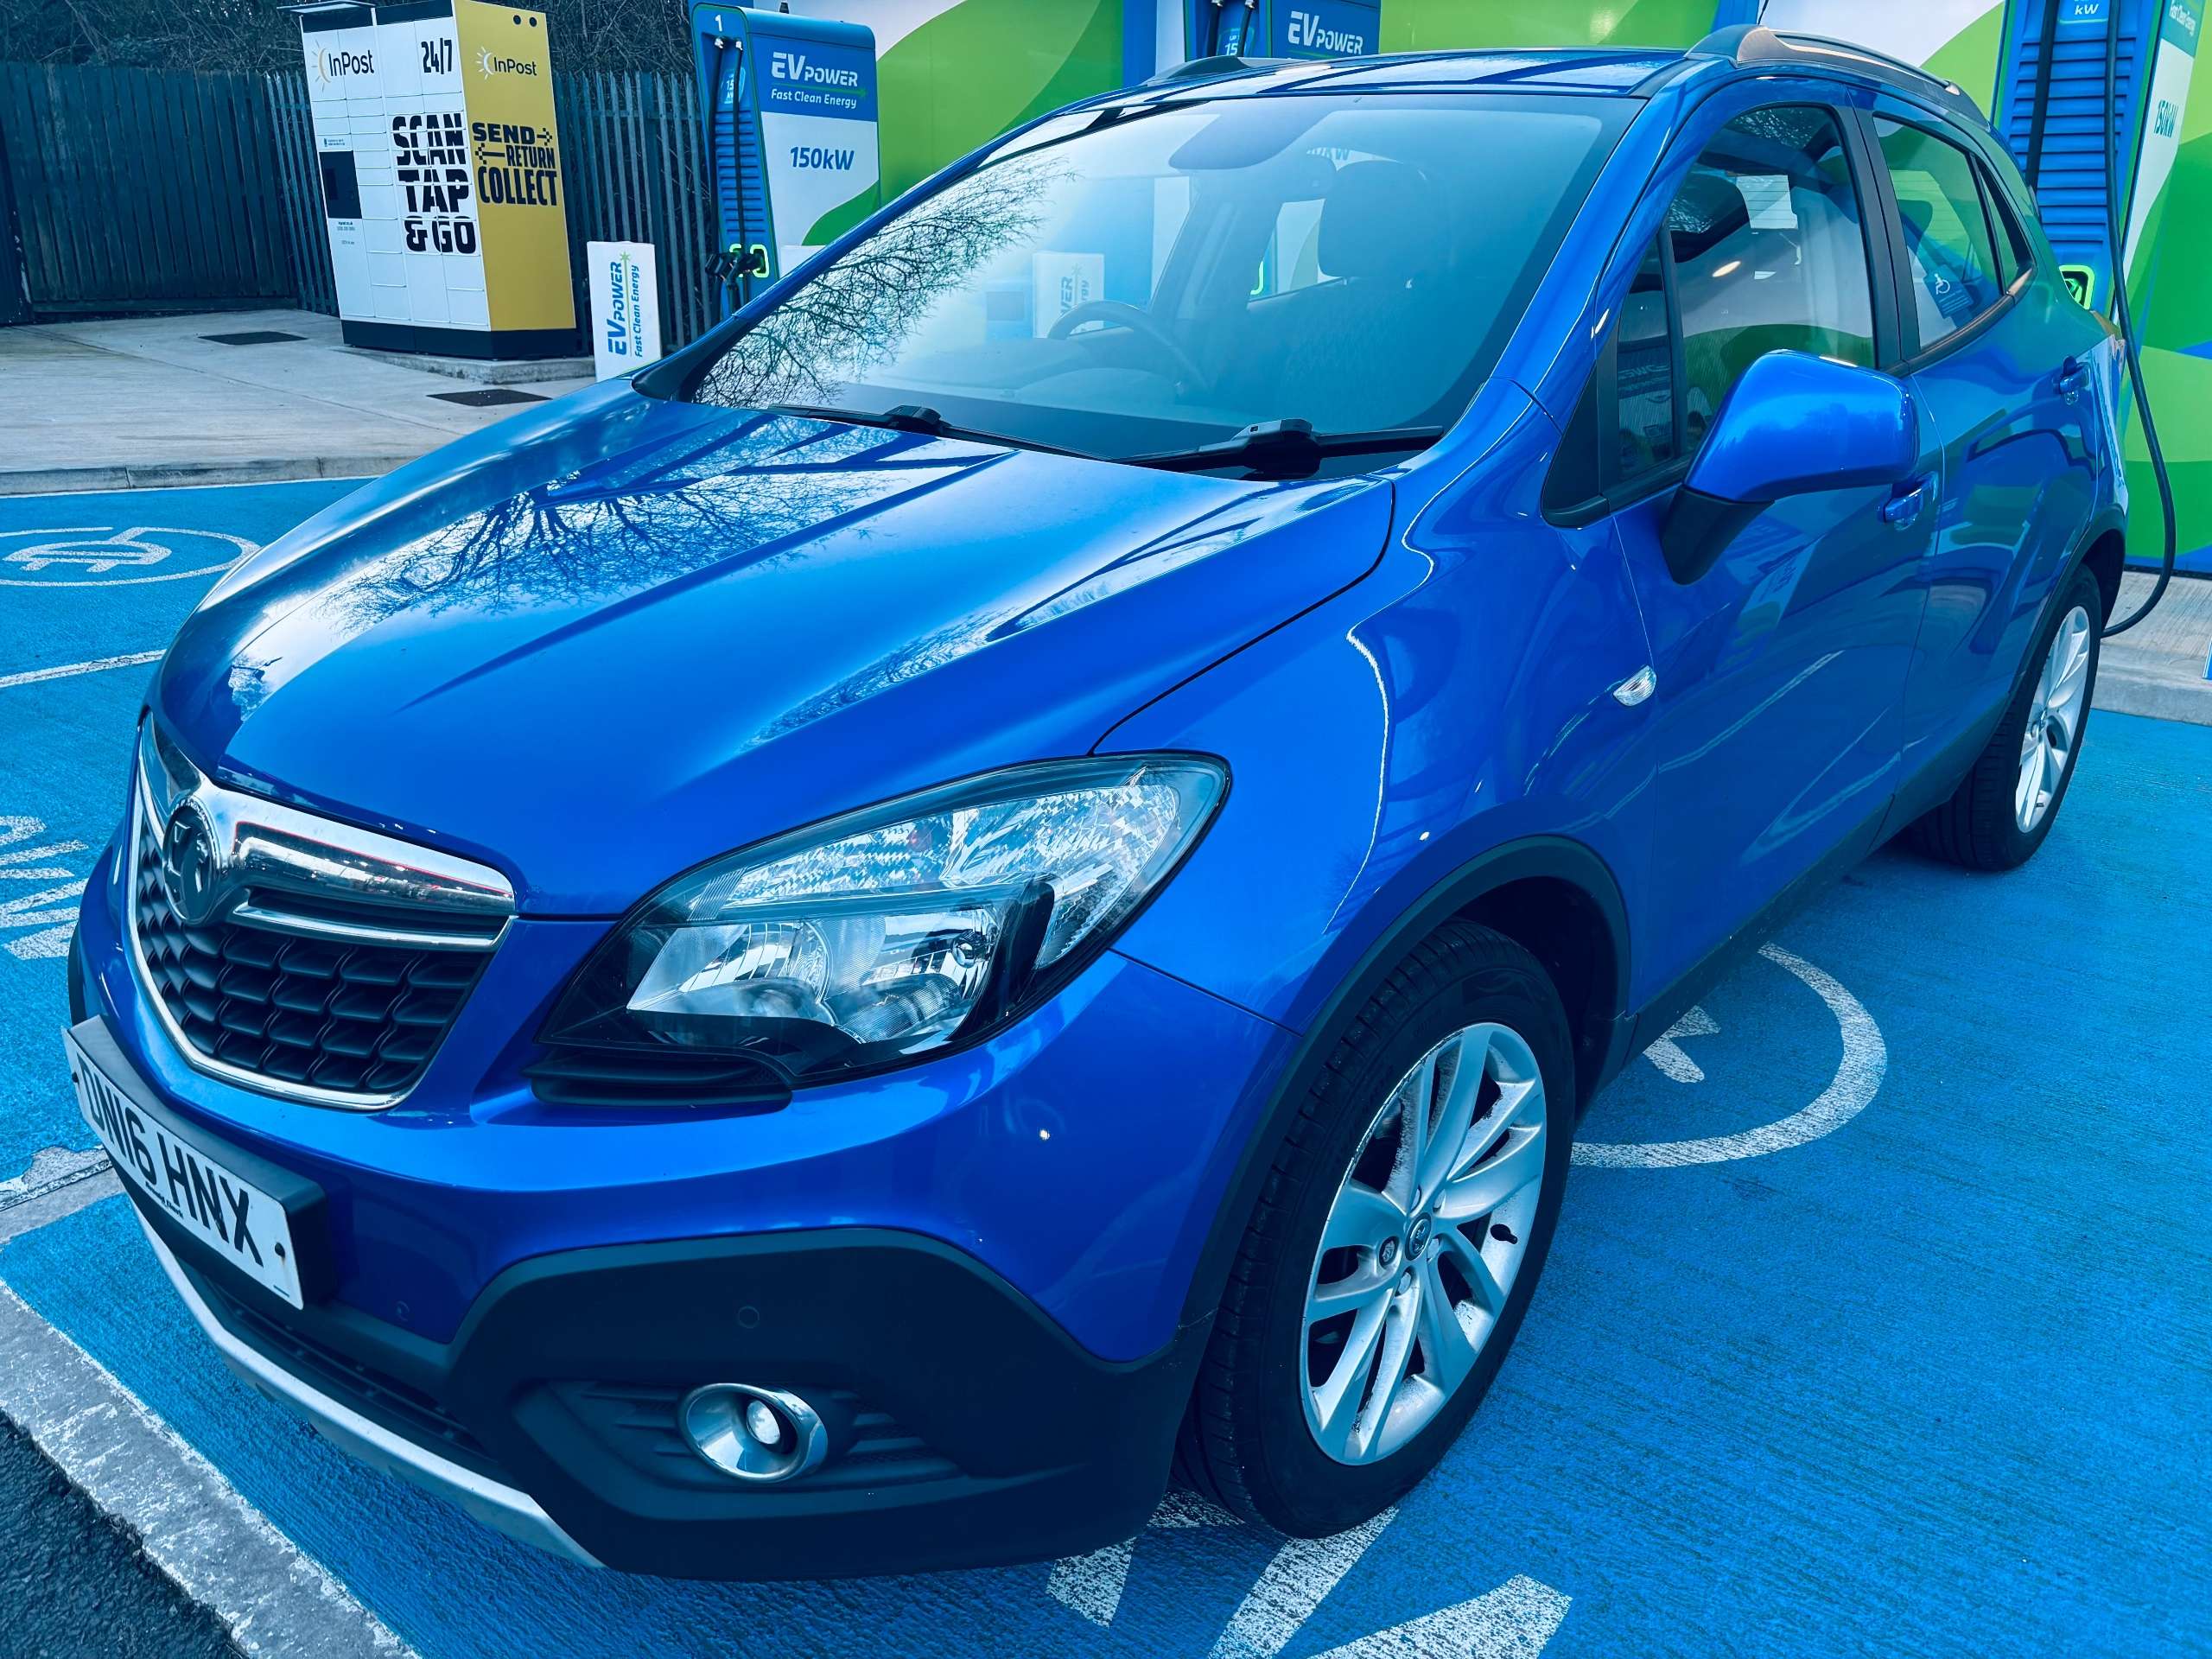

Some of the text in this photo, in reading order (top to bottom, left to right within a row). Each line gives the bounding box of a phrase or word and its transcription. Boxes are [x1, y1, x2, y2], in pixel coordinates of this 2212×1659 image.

[2075, 3, 2099, 15] kW
[715, 14, 723, 32] 1
[1224, 42, 1239, 56] 15
[328, 49, 375, 77] InPost
[493, 57, 537, 76] InPost
[771, 88, 857, 109] Fast Clean Energy
[392, 112, 467, 166] SCAN
[472, 122, 535, 145] SEND
[506, 144, 556, 169] RETURN
[790, 146, 855, 171] 150kW
[397, 168, 469, 213] TAP
[478, 165, 557, 206] COLLECT
[404, 215, 476, 254] & GO
[631, 264, 643, 357] Fast Clean Energy
[156, 1131, 264, 1268] HNX
